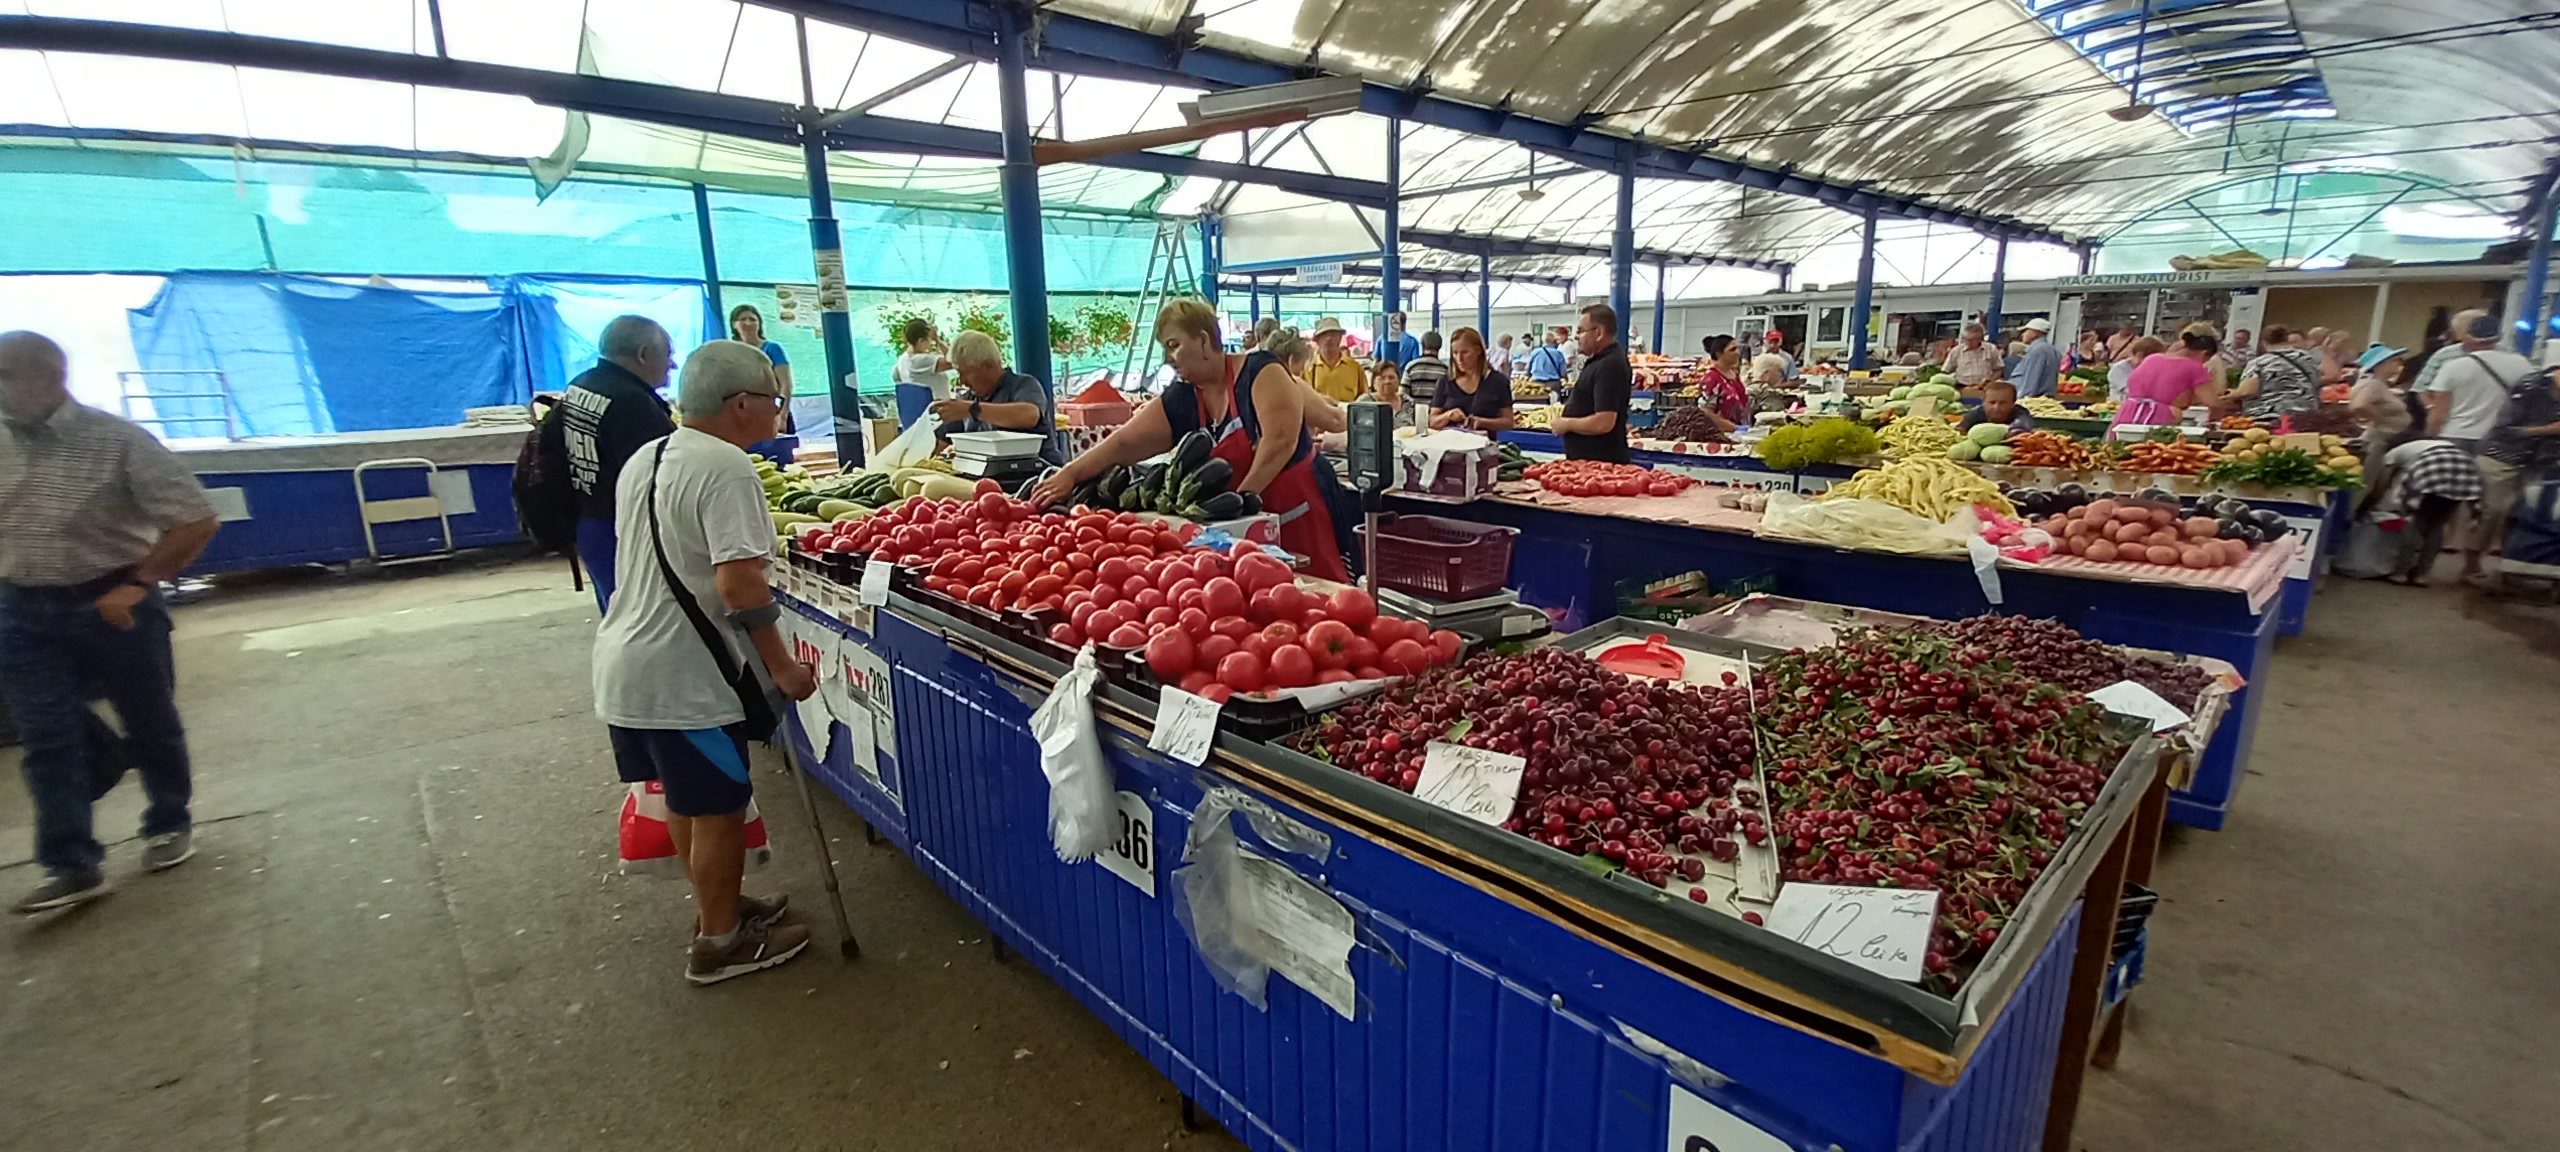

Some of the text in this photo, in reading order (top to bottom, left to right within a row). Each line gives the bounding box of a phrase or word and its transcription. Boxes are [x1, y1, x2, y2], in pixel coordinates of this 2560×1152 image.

[2057, 275, 2132, 287] MAGAZIN
[2135, 271, 2211, 284] NATURIST
[869, 666, 890, 710] 287
[1423, 760, 1479, 810] 12
[1796, 901, 1853, 957] 12
